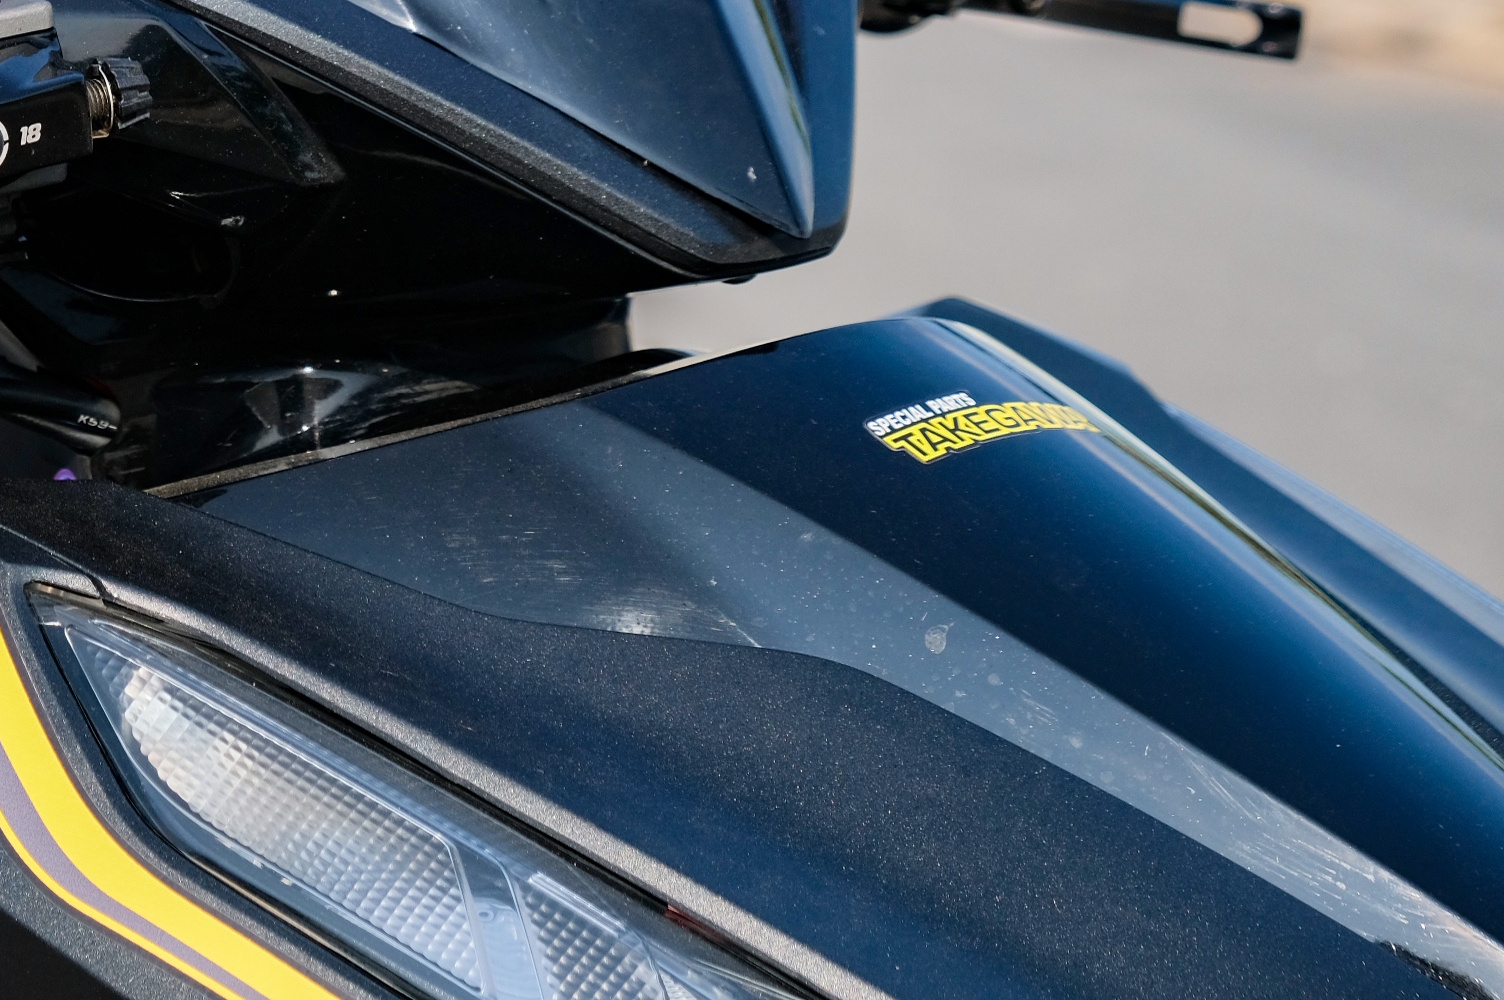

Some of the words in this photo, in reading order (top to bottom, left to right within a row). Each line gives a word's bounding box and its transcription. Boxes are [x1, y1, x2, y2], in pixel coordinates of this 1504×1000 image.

[19, 122, 42, 146] 18
[866, 404, 934, 437] SPECIAL
[925, 392, 977, 415] PARTS
